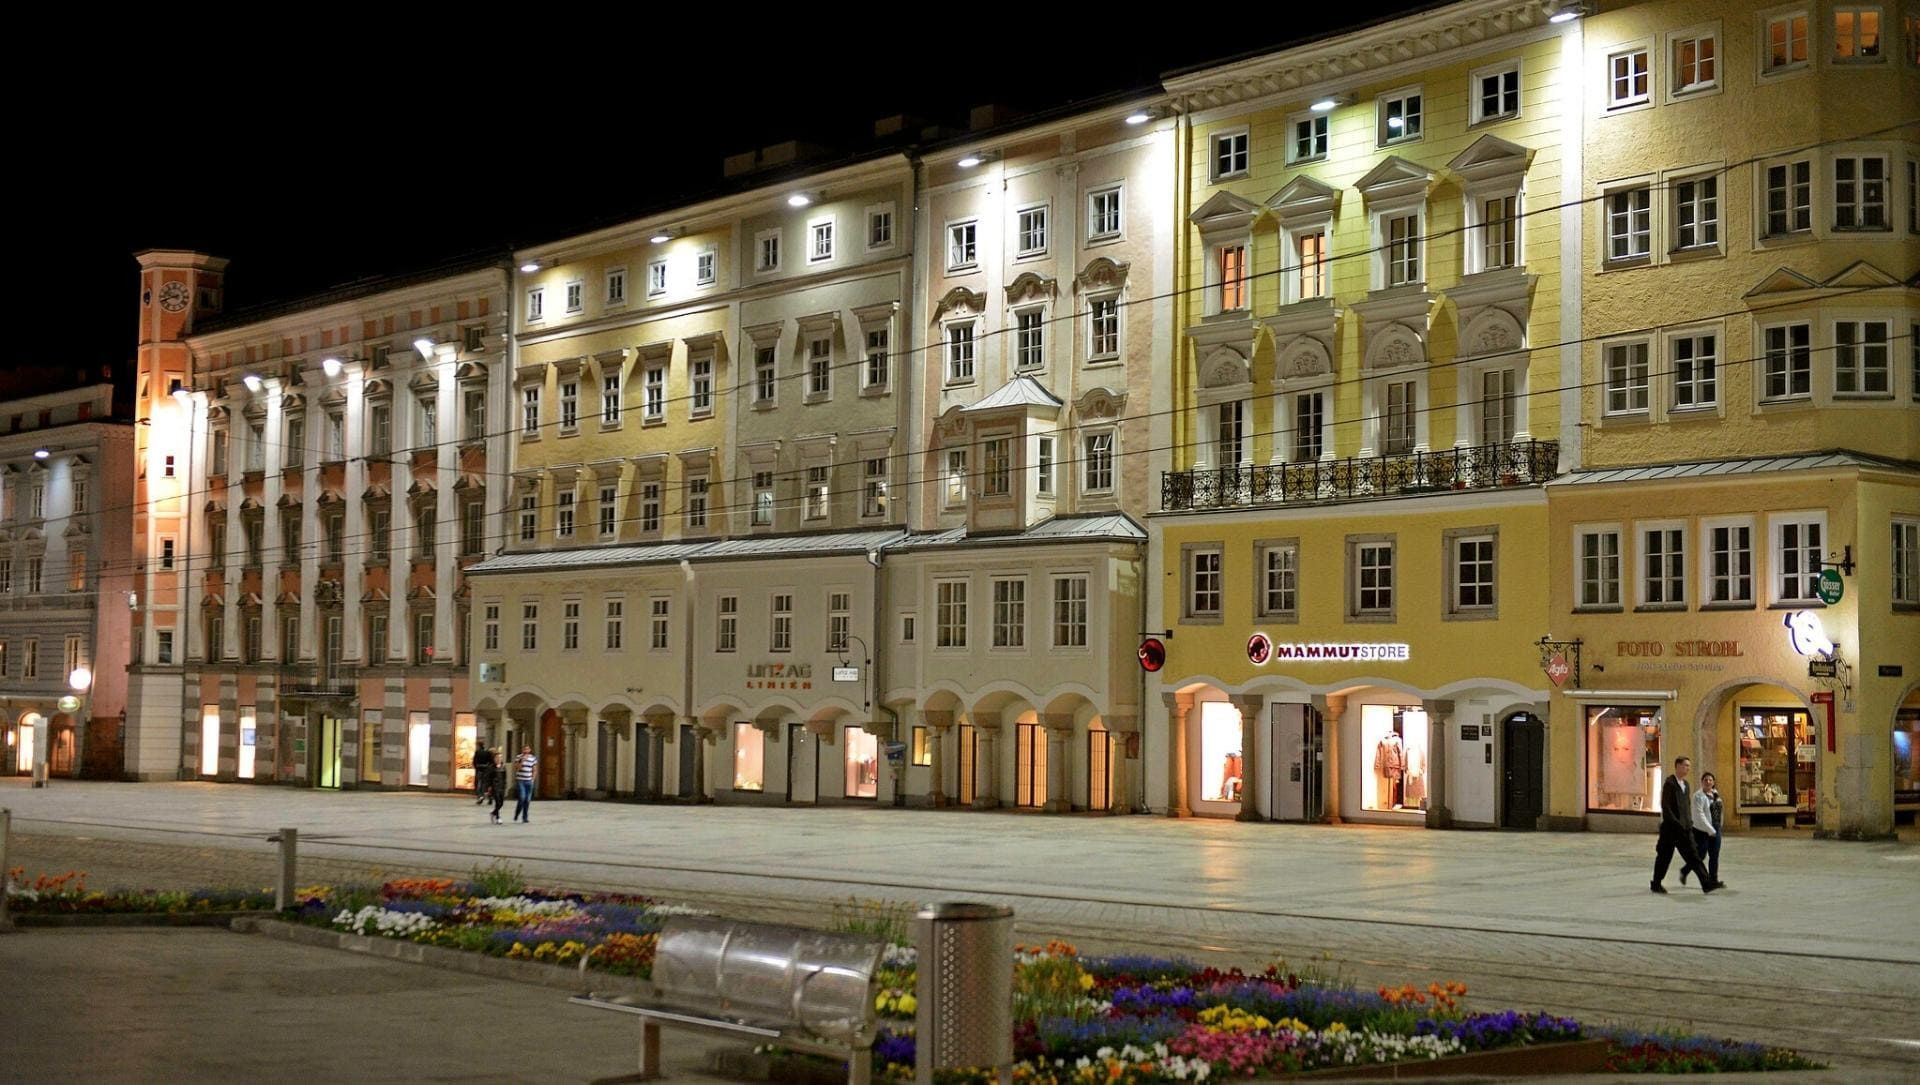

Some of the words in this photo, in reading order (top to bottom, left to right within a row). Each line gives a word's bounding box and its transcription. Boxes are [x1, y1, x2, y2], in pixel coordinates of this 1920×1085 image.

[1617, 640, 1665, 657] FOTO
[786, 664, 812, 678] AG
[1548, 663, 1569, 677] Agfa
[746, 681, 812, 689] LINIEN
